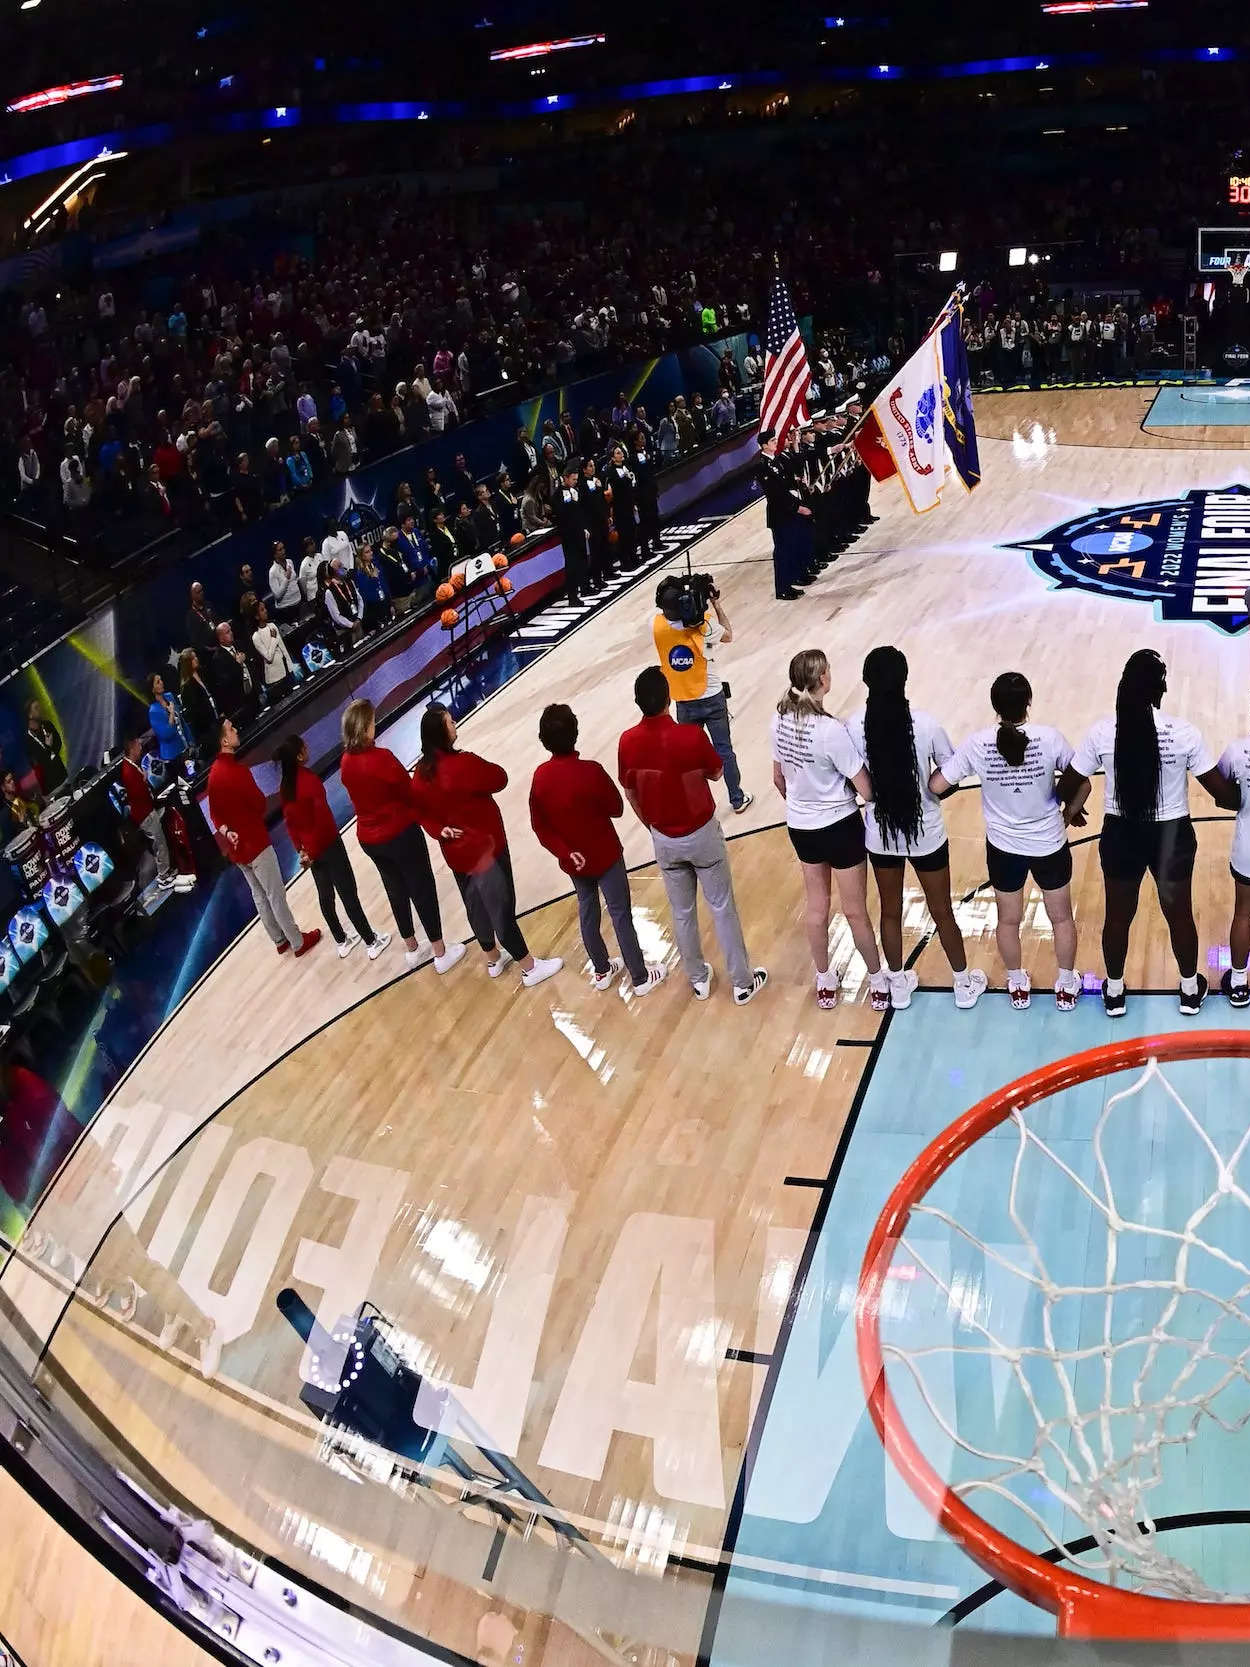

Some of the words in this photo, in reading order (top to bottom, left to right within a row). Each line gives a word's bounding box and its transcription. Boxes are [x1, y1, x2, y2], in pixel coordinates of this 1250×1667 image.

[1209, 257, 1231, 265] FOUR
[1165, 514, 1189, 551] WOMEN'S
[1160, 553, 1182, 576] 2022
[671, 657, 694, 666] NCAA
